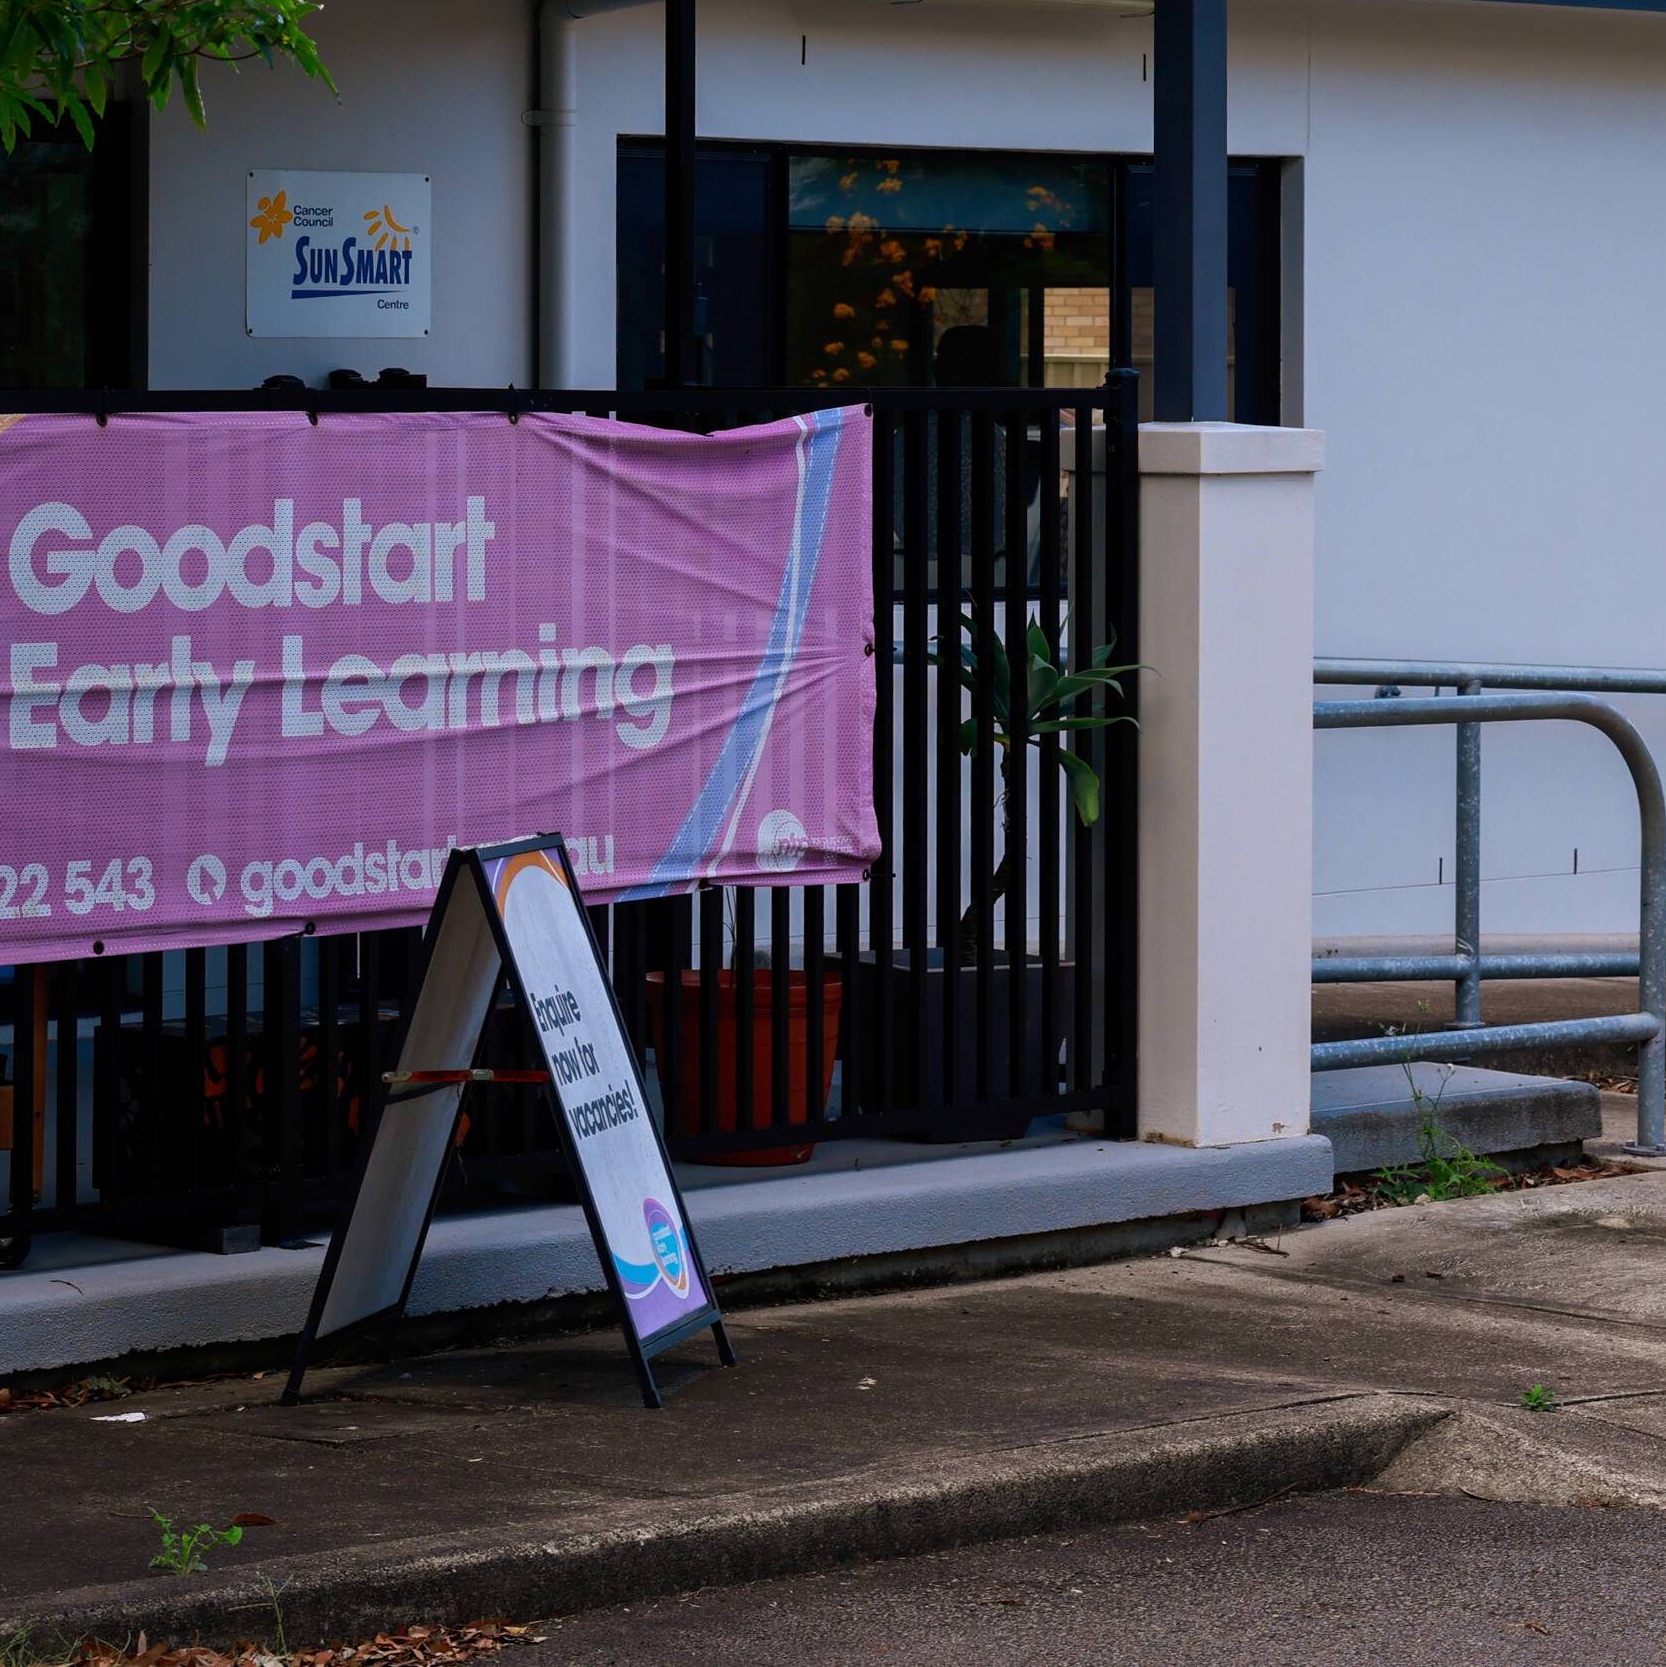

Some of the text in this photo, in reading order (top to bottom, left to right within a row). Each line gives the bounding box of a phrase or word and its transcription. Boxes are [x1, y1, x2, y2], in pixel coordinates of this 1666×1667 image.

[293, 205, 333, 216] Cancer
[293, 216, 333, 228] Council
[377, 299, 409, 310] Centre
[9, 495, 496, 616] Goodstart
[9, 623, 674, 767] Early Learning
[65, 857, 154, 916] 543
[530, 985, 581, 1036] Enquire
[551, 1037, 600, 1086] now for
[568, 1079, 639, 1140] vacancies!
